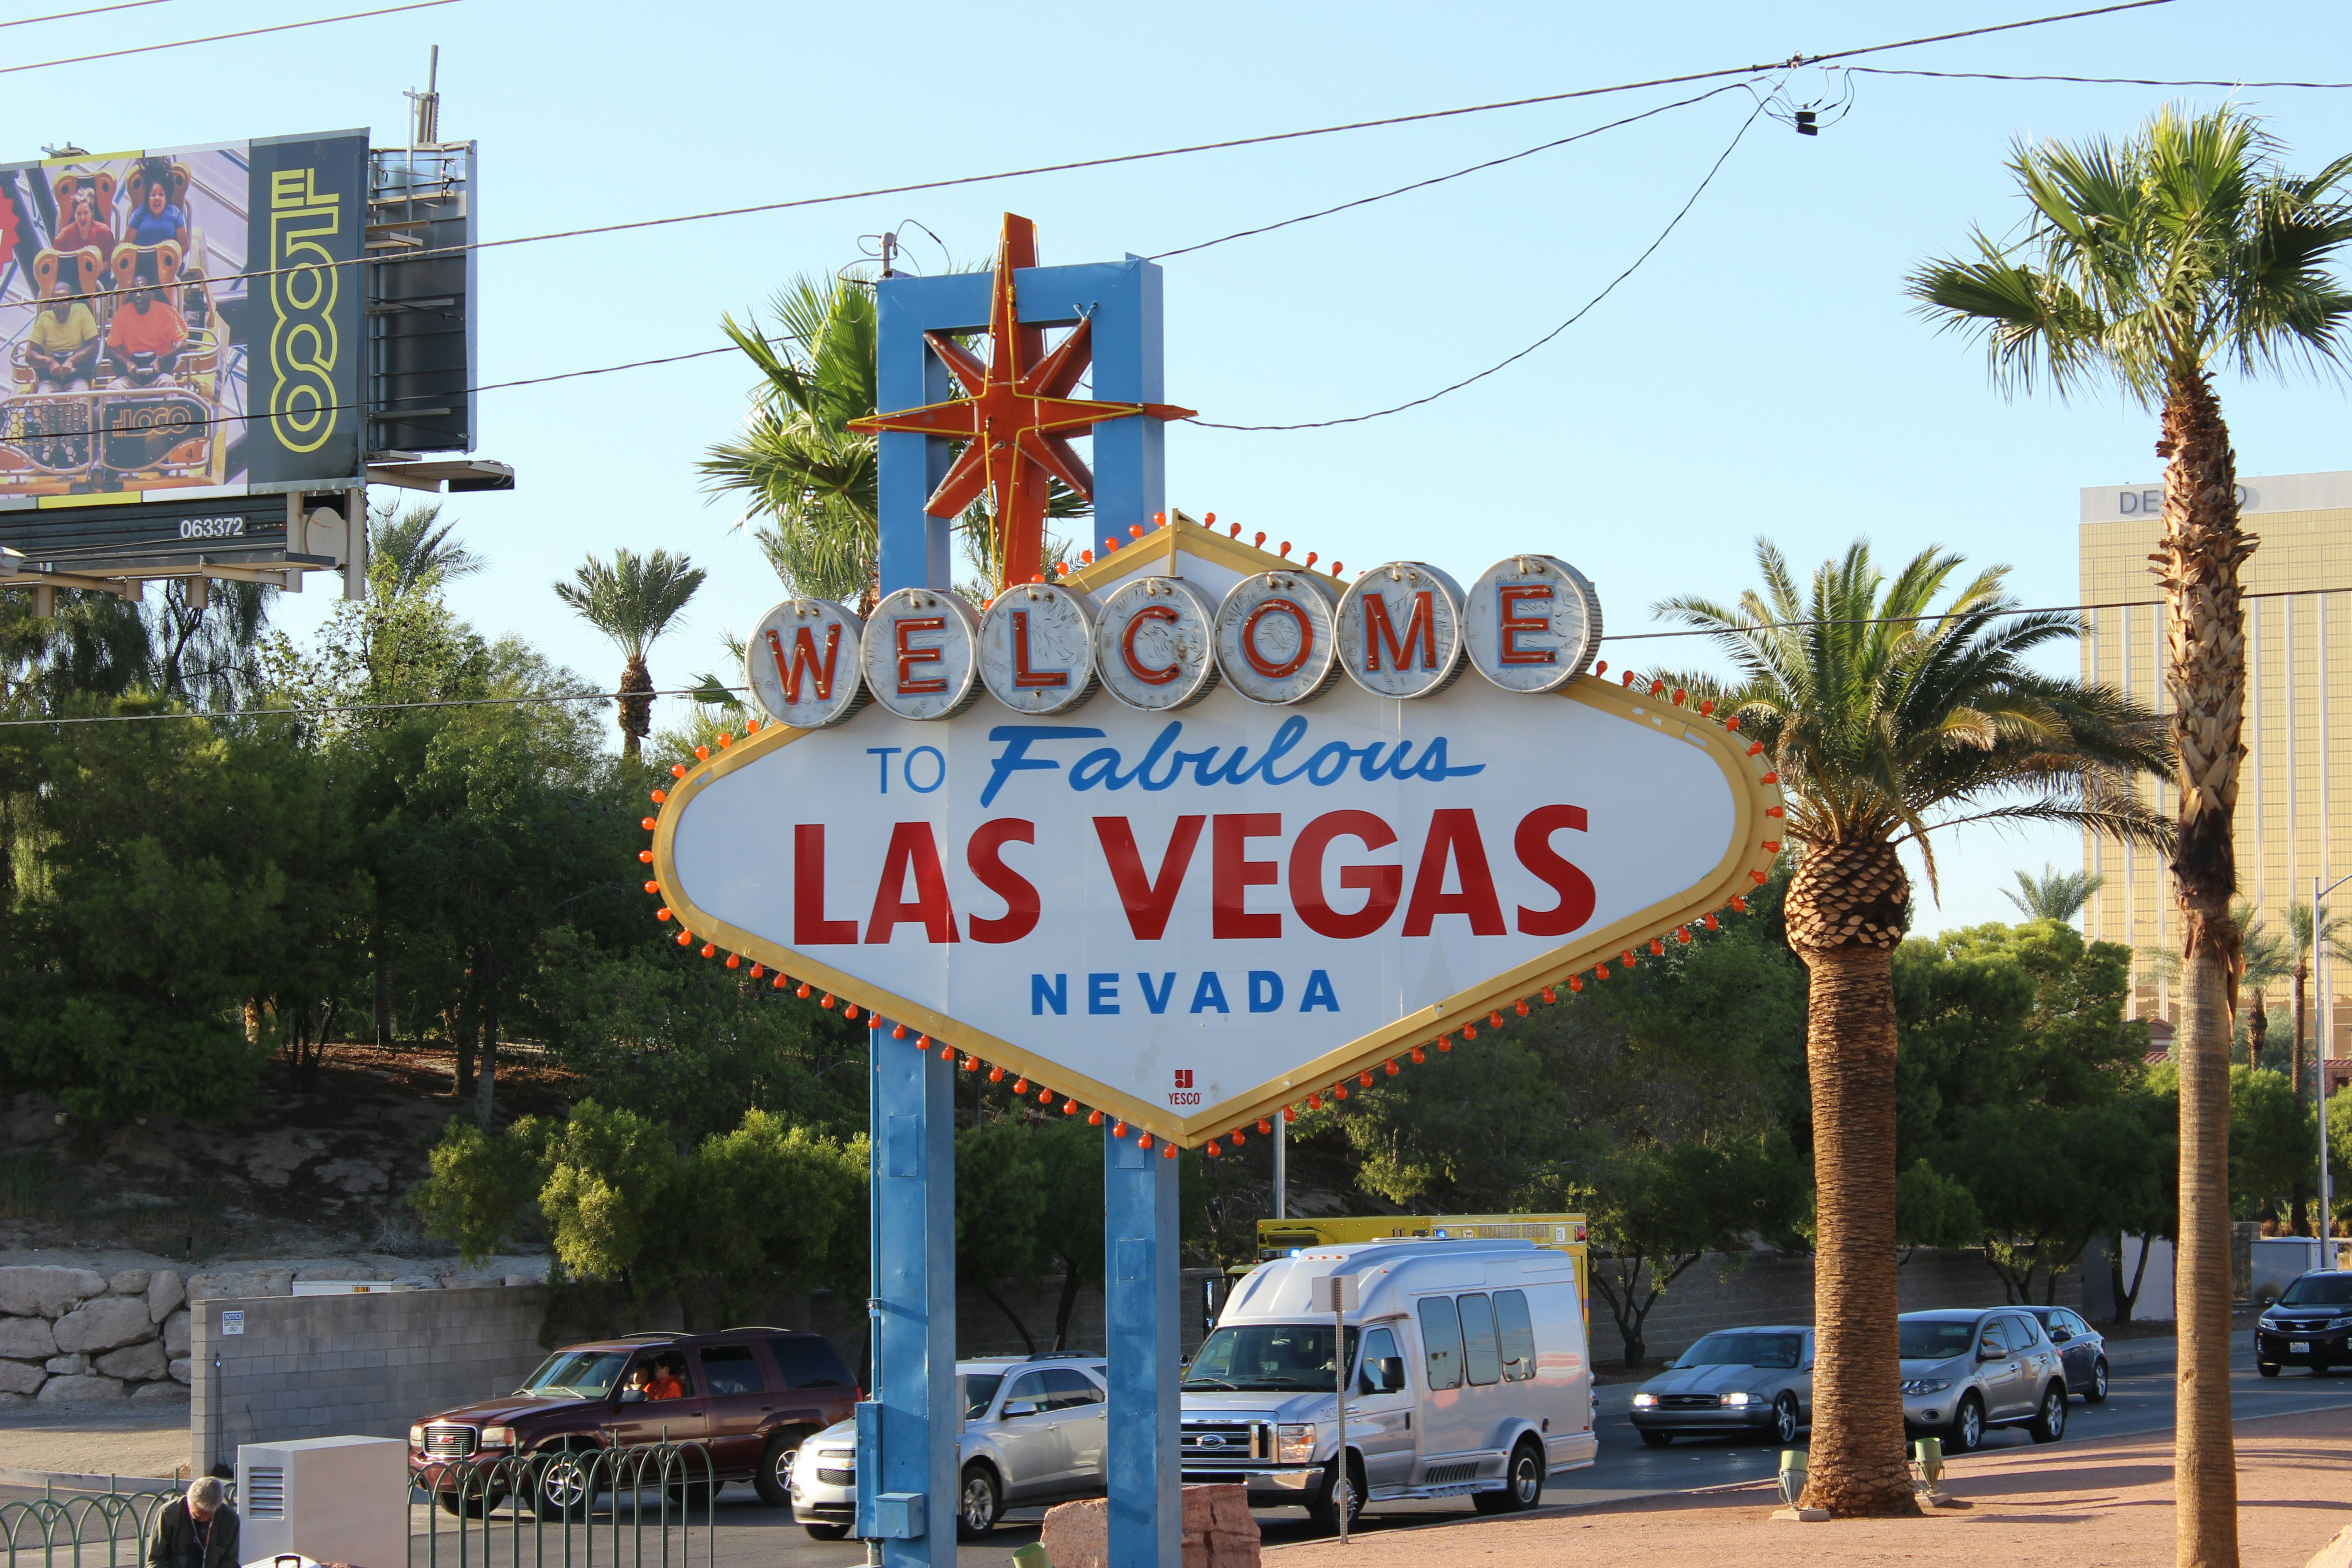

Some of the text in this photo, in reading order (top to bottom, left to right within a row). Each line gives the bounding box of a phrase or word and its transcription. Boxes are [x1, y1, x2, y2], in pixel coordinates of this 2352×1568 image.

[270, 168, 339, 453] EL LOCO
[185, 448, 194, 459] 4
[180, 517, 243, 539] 063372
[765, 583, 1557, 706] WELCOME
[867, 715, 1486, 808] TO Fabulous
[795, 804, 1596, 945] LAS VEGAS
[1032, 970, 1340, 1015] NEVADA
[1168, 1092, 1200, 1105] YESCO
[1479, 1225, 1549, 1238] PARAMEDIC RESCUE
